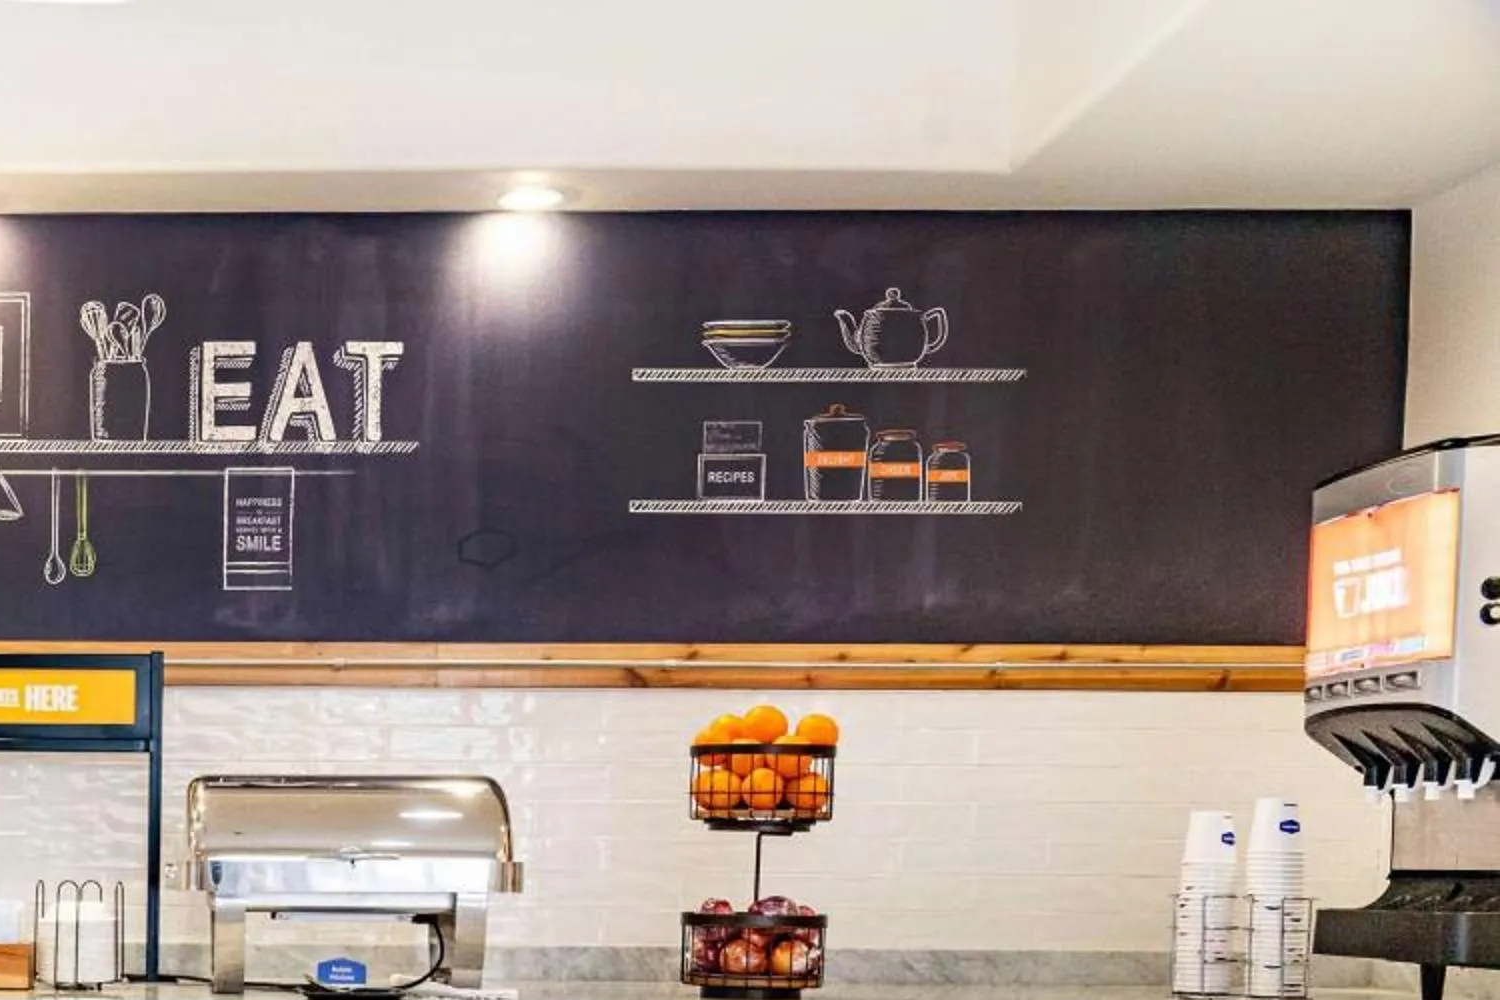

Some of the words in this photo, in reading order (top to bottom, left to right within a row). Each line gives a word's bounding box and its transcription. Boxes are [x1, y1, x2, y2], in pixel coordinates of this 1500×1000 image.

[190, 341, 404, 442] EAT
[707, 471, 755, 484] RECIPES
[235, 535, 282, 551] SMILE
[25, 685, 79, 712] HERE
